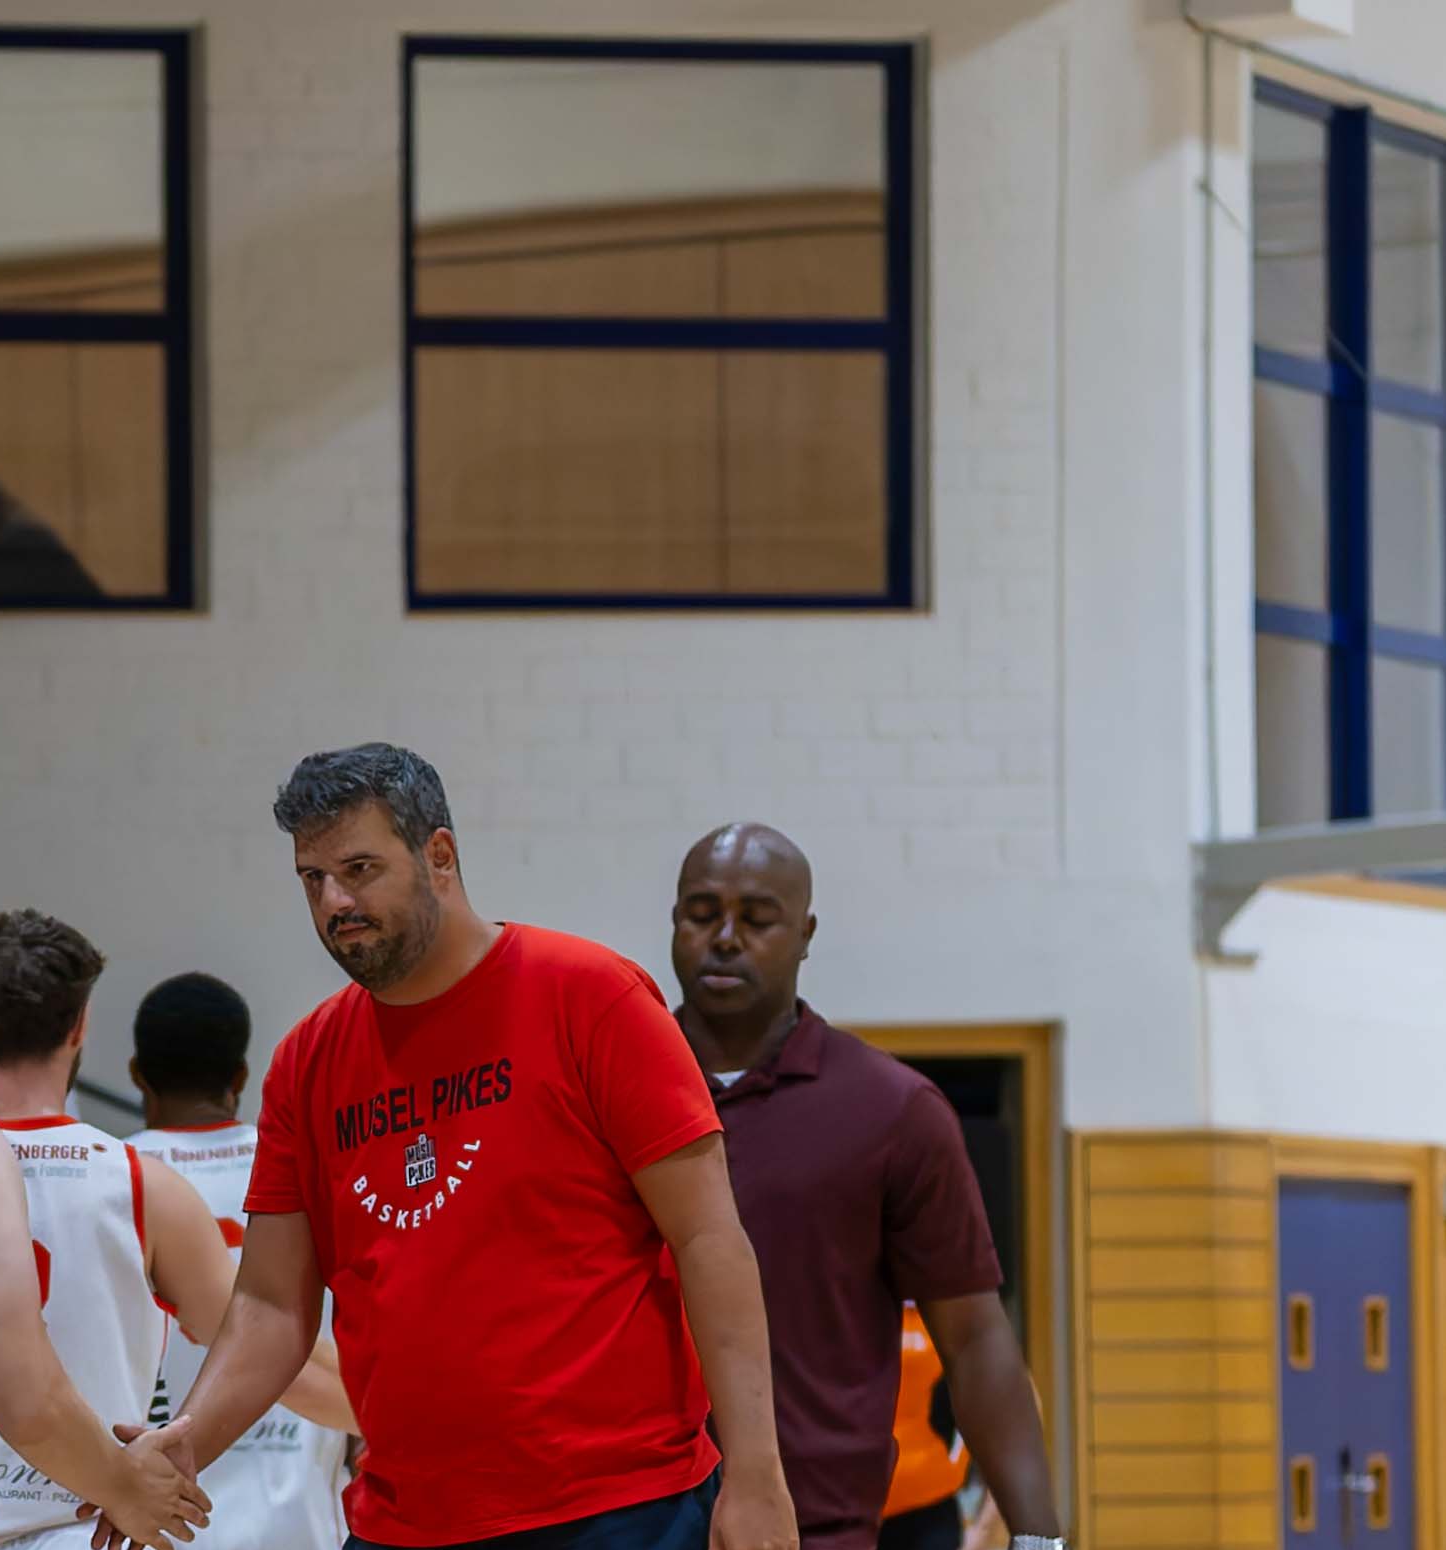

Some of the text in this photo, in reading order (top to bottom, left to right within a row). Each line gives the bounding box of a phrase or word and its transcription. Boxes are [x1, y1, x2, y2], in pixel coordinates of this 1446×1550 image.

[335, 1058, 512, 1152] MUSEL PIKES
[353, 1140, 481, 1229] BASKETBALL
